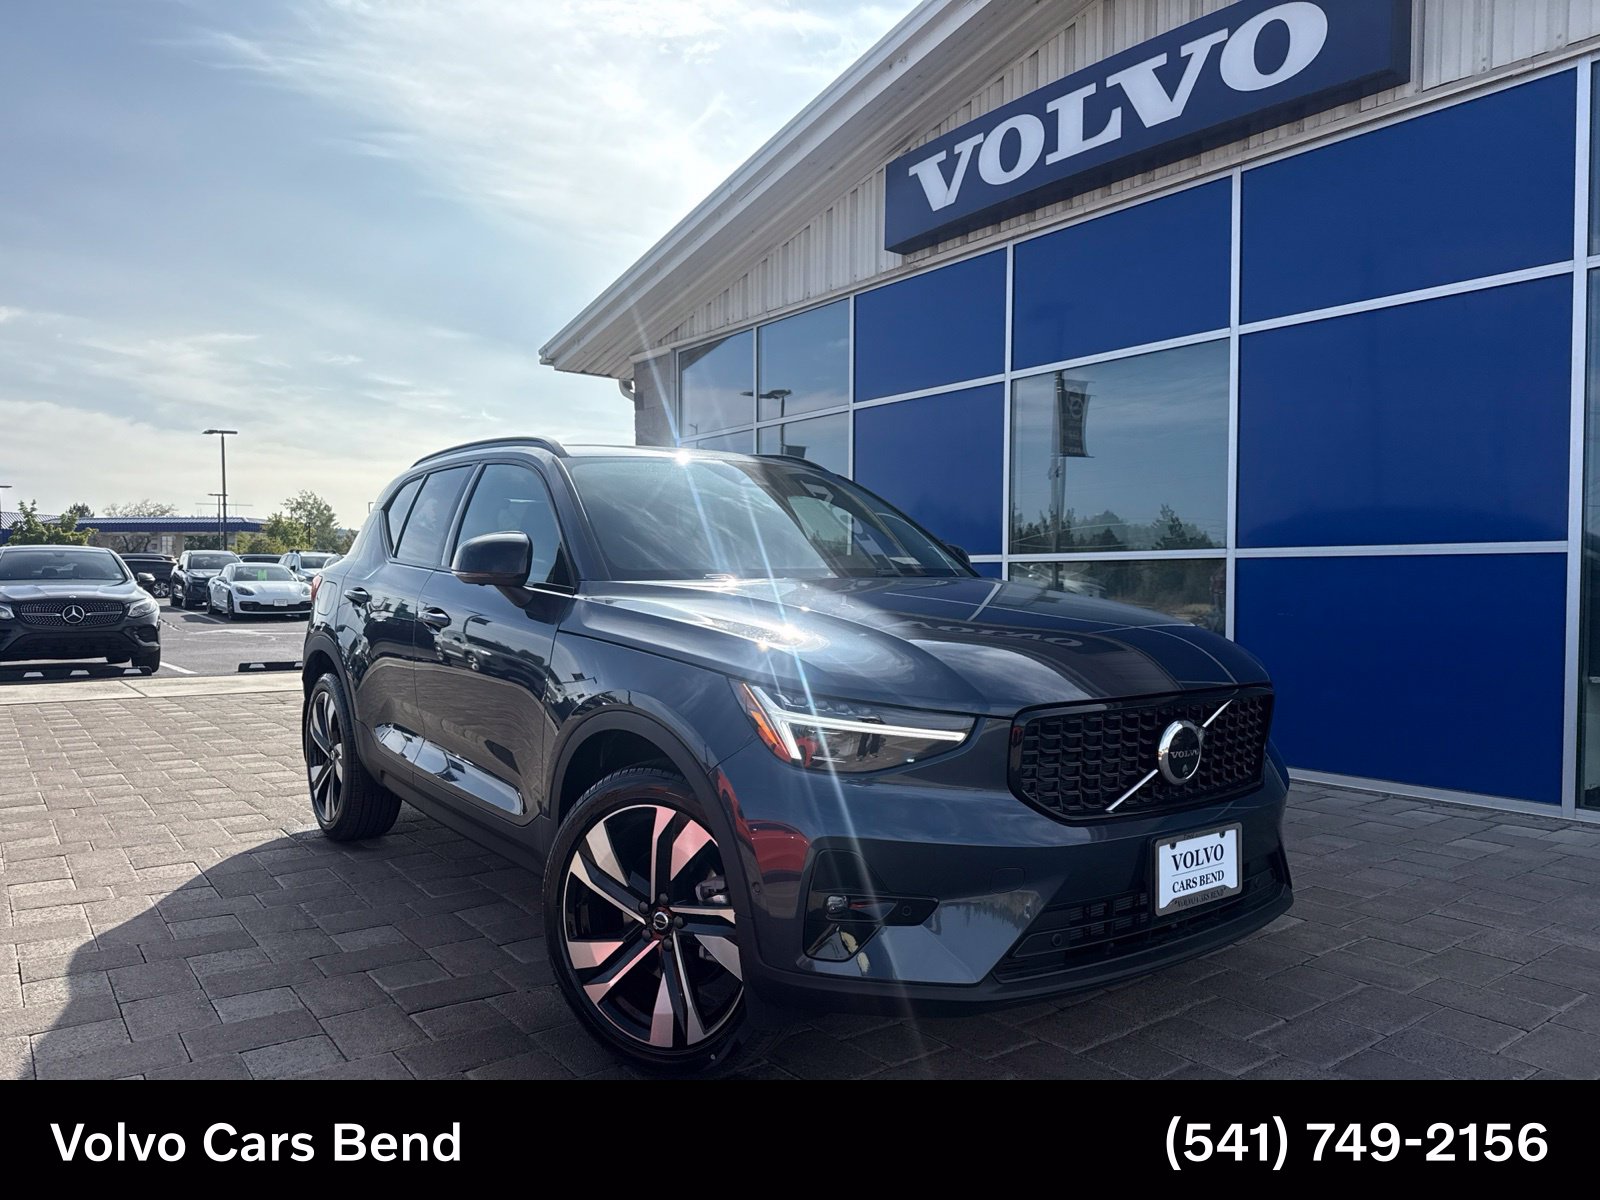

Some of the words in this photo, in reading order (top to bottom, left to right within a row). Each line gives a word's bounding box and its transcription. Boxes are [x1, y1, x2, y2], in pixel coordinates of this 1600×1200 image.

[908, 1, 1329, 212] VOLVO
[1171, 843, 1224, 871] VOLVO
[1172, 876, 1198, 893] CARS
[1199, 870, 1225, 886] BEND
